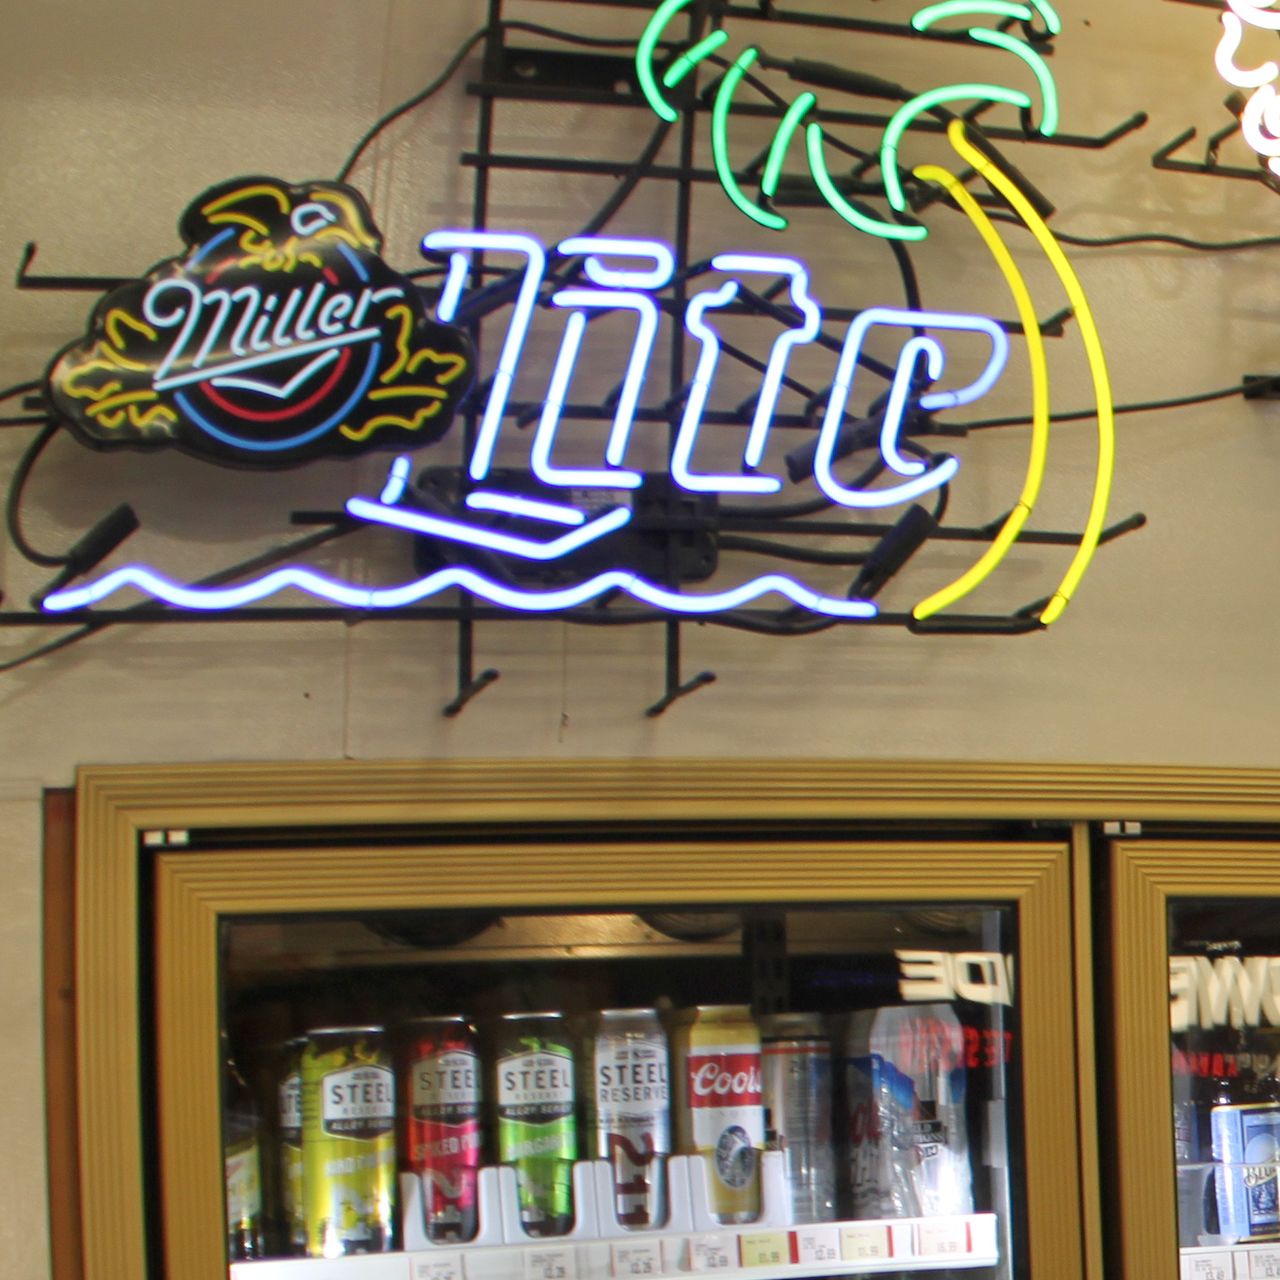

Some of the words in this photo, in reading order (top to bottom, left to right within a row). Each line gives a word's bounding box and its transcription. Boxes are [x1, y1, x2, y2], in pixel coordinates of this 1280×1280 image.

[143, 280, 404, 390] Miller
[345, 230, 1009, 562] Lite
[504, 1069, 572, 1092] STEEL
[600, 1064, 667, 1086] STEEL
[331, 1083, 393, 1106] STEEL
[600, 1083, 668, 1103] RESERVE
